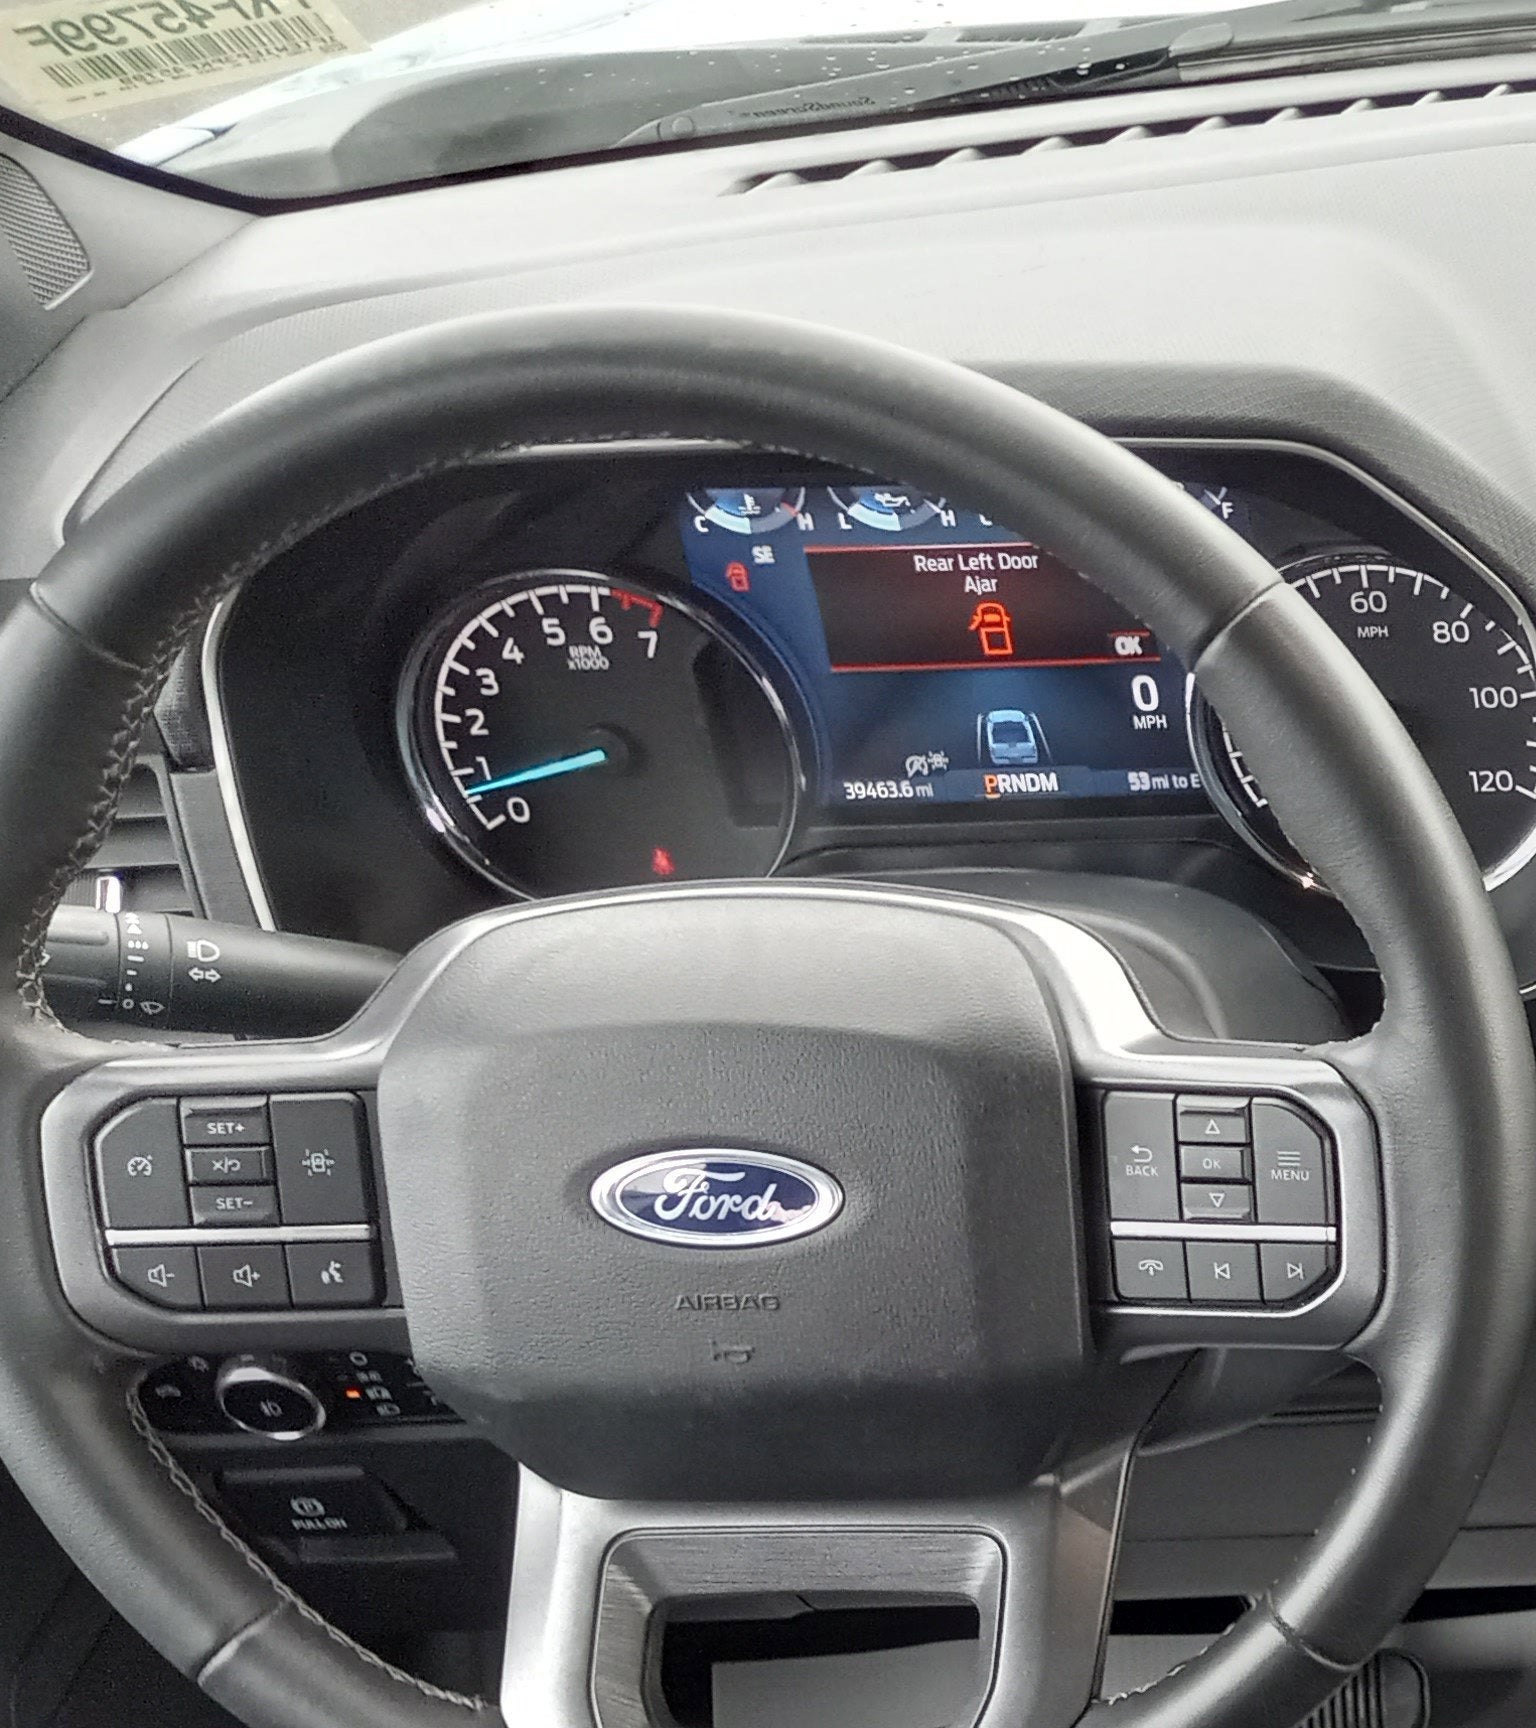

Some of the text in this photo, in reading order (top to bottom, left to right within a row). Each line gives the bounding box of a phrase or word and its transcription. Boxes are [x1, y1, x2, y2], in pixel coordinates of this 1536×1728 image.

[913, 553, 1038, 574] Rear Left Door
[964, 574, 998, 597] Ajar
[1350, 591, 1388, 614] 60
[541, 618, 567, 647] 5
[588, 616, 614, 645] 6
[1357, 625, 1389, 639] MPH
[1432, 620, 1470, 644] 80
[501, 637, 525, 665] 4
[568, 645, 602, 659] RPM
[637, 630, 659, 659] 7
[1114, 635, 1143, 655] OK
[475, 667, 501, 697] 3
[1131, 674, 1160, 712] 0
[1469, 686, 1518, 710] 100
[464, 708, 490, 736] 2
[1133, 715, 1168, 730] MPH
[843, 781, 914, 800] 39463.6
[1128, 772, 1150, 791] 53
[1172, 774, 1189, 790] to
[1469, 770, 1514, 793] 120
[506, 797, 531, 823] 0
[1125, 1164, 1160, 1177] BACK
[1202, 1157, 1222, 1170] OK
[1270, 1168, 1310, 1182] MENU
[653, 1167, 778, 1221] Ford
[675, 1293, 782, 1312] AIRBAG
